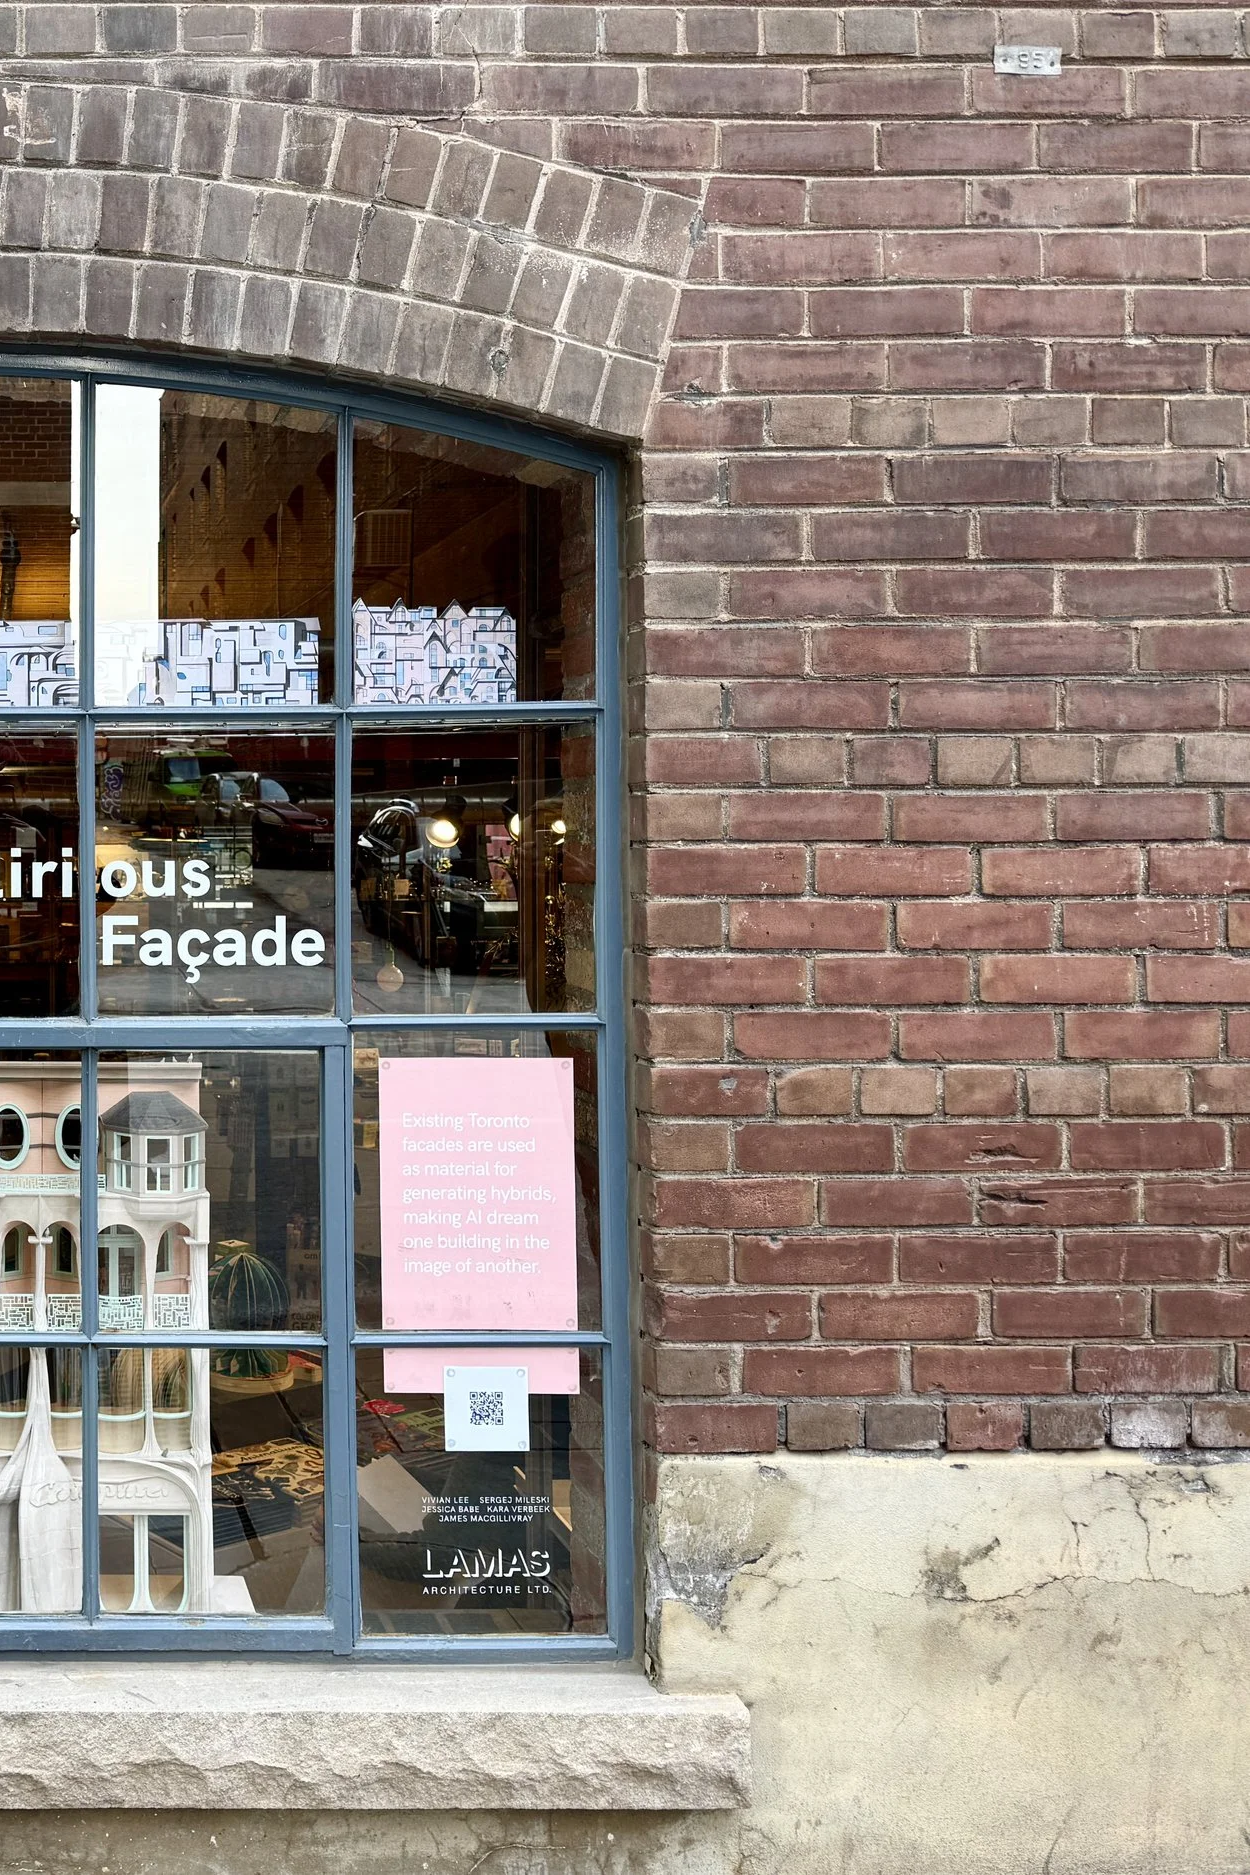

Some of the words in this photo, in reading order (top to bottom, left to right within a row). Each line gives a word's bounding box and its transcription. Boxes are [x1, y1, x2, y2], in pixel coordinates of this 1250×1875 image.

[103, 915, 326, 983] Façade
[402, 1113, 463, 1131] Existing
[468, 1113, 530, 1128] Toronto
[402, 1137, 463, 1152] facades
[467, 1141, 494, 1152] are
[498, 1137, 536, 1152] used
[402, 1164, 420, 1176] as
[425, 1161, 489, 1176] material
[494, 1161, 517, 1176] for
[402, 1186, 486, 1204] generating
[491, 1186, 556, 1204] hybrids,
[404, 1210, 461, 1228] making
[466, 1210, 482, 1225] AI
[487, 1209, 538, 1225] dream
[403, 1237, 433, 1249] one
[438, 1234, 501, 1252] building
[506, 1235, 519, 1249] in
[524, 1235, 550, 1249] the
[404, 1259, 451, 1276] image
[455, 1258, 472, 1273] of
[476, 1259, 541, 1273] another.
[421, 1496, 451, 1504] VIVIAN
[454, 1496, 469, 1504] LEE
[479, 1496, 513, 1504] SERGEJ
[515, 1496, 550, 1504] MILESKI
[439, 1515, 468, 1523] JAMES
[470, 1515, 533, 1523] MACGILLIVRAY
[422, 1548, 551, 1578] LAMAS
[422, 1586, 521, 1595] ARCHITECTURE
[527, 1586, 552, 1595] LTD.
